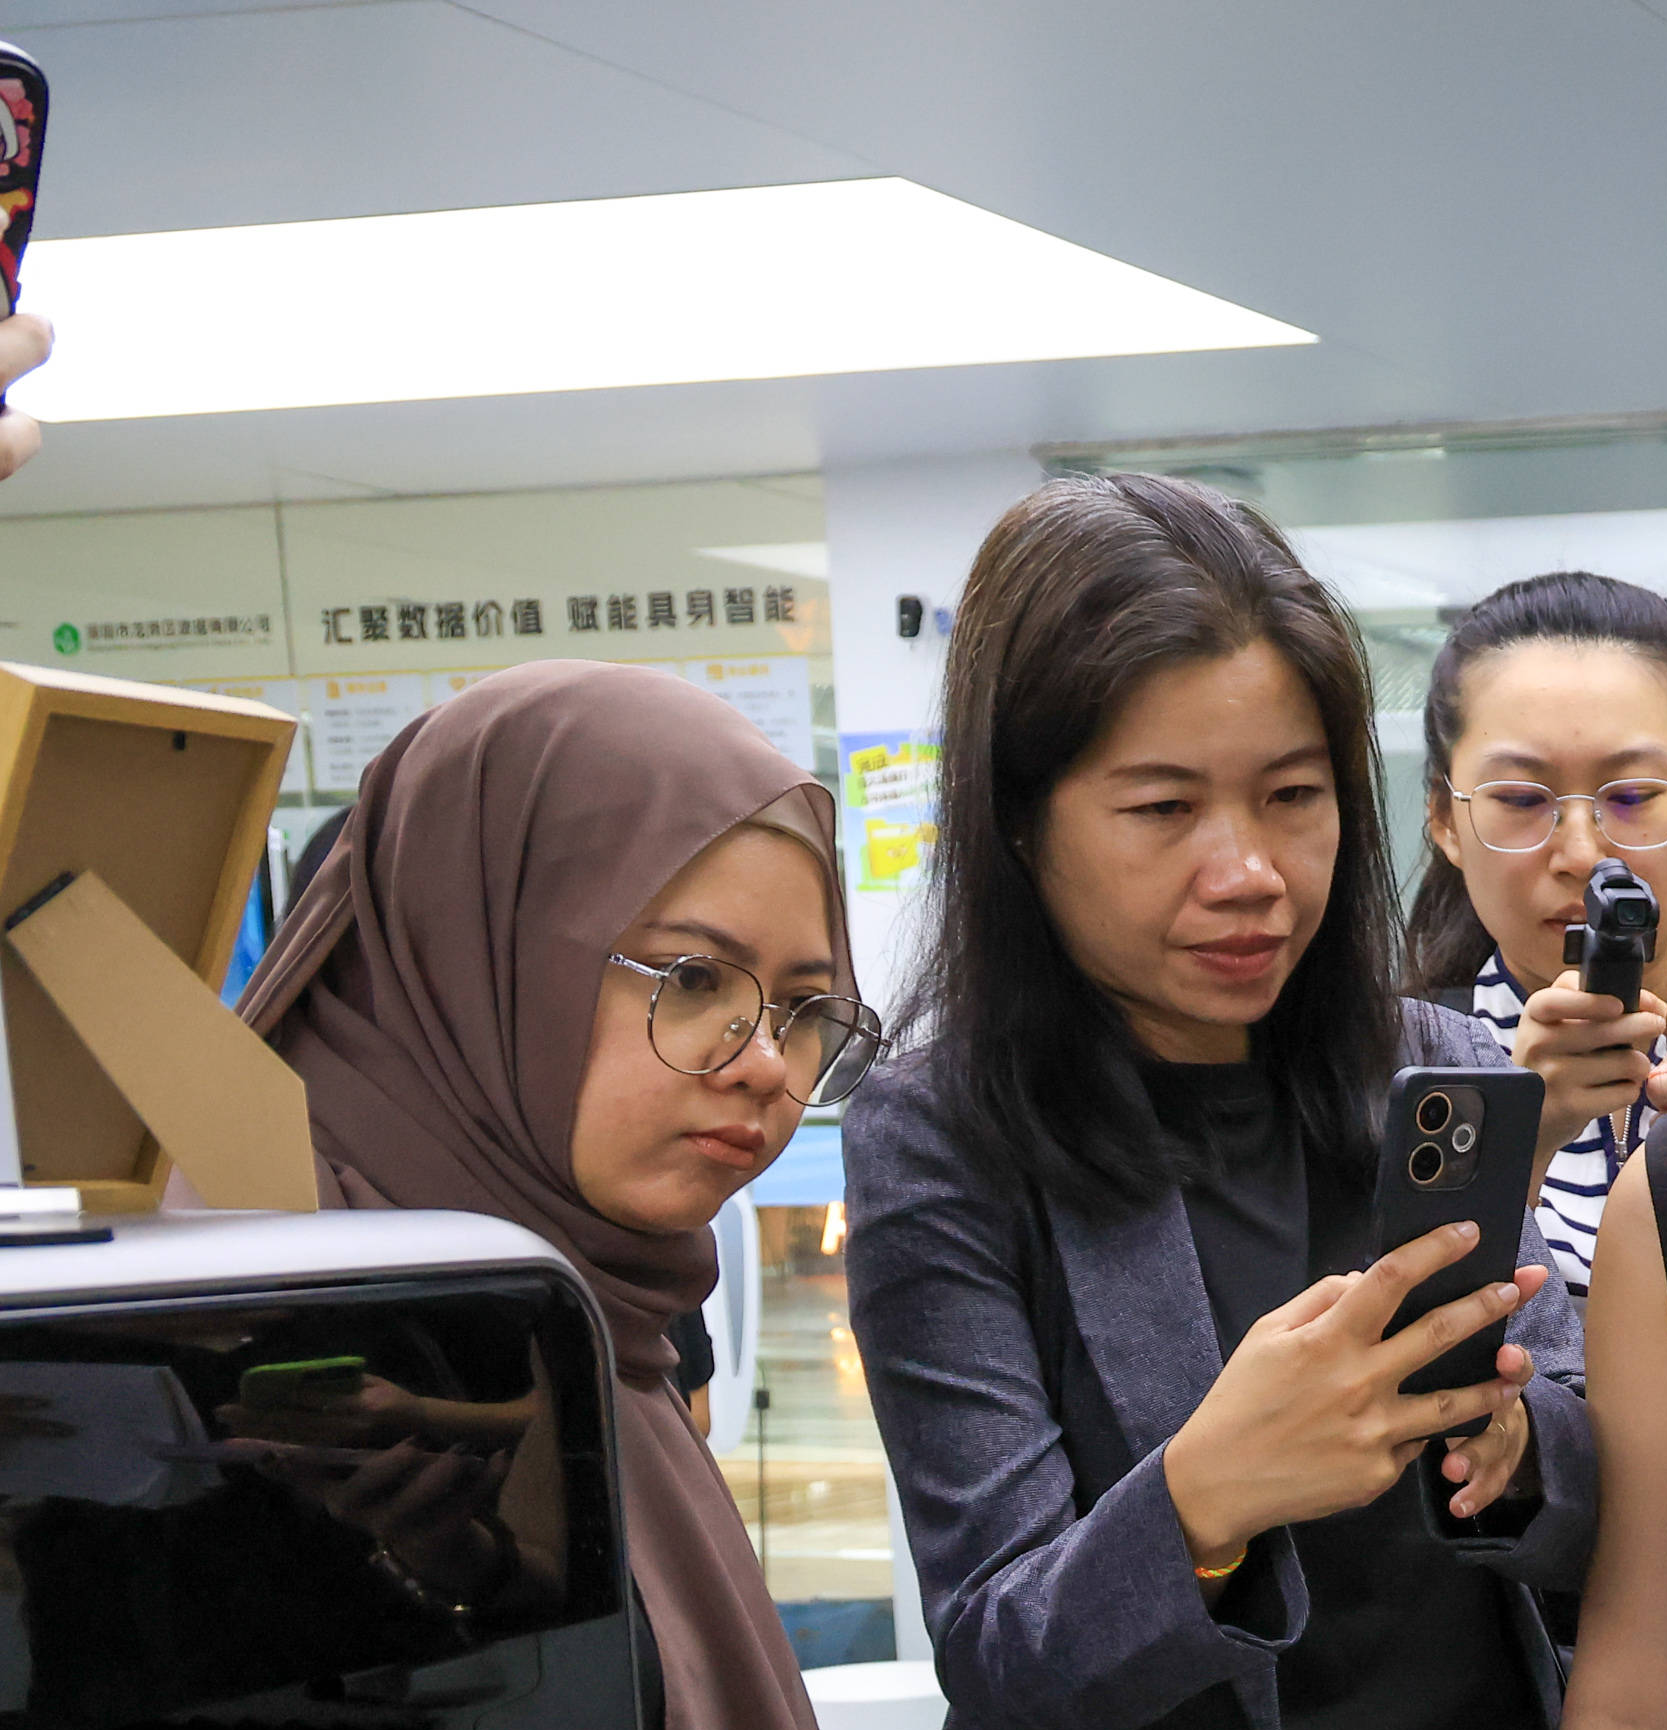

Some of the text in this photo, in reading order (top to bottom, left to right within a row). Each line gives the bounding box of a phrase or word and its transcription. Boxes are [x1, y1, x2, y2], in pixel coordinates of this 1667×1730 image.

[321, 584, 798, 646] 汇聚数据价值 赋能具身智能
